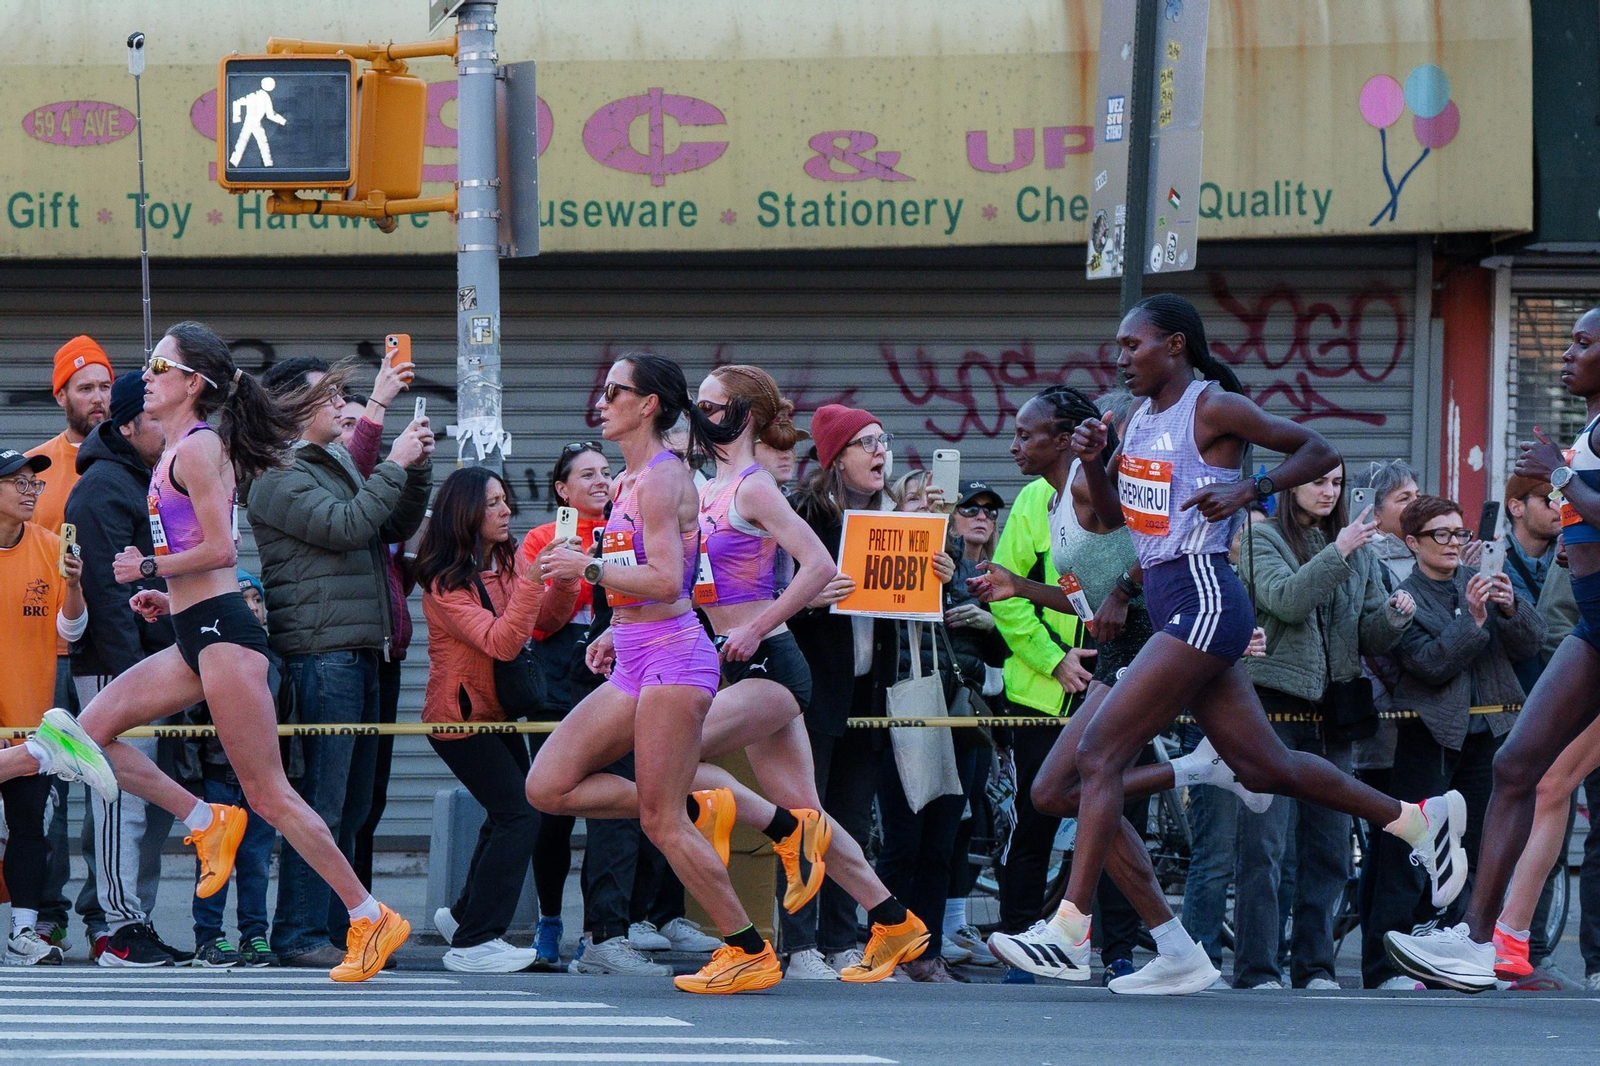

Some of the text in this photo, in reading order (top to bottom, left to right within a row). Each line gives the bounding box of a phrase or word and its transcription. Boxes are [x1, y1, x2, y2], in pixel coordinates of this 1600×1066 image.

[34, 110, 55, 138] 59
[967, 126, 1095, 173] UP
[7, 191, 80, 229] Gift
[126, 192, 192, 239] Toy
[757, 190, 964, 235] Stationery
[1198, 180, 1333, 226] Quality
[868, 528, 930, 552] PRETTY WEIRD
[863, 554, 929, 591] HOBBY
[22, 605, 50, 617] BRC
